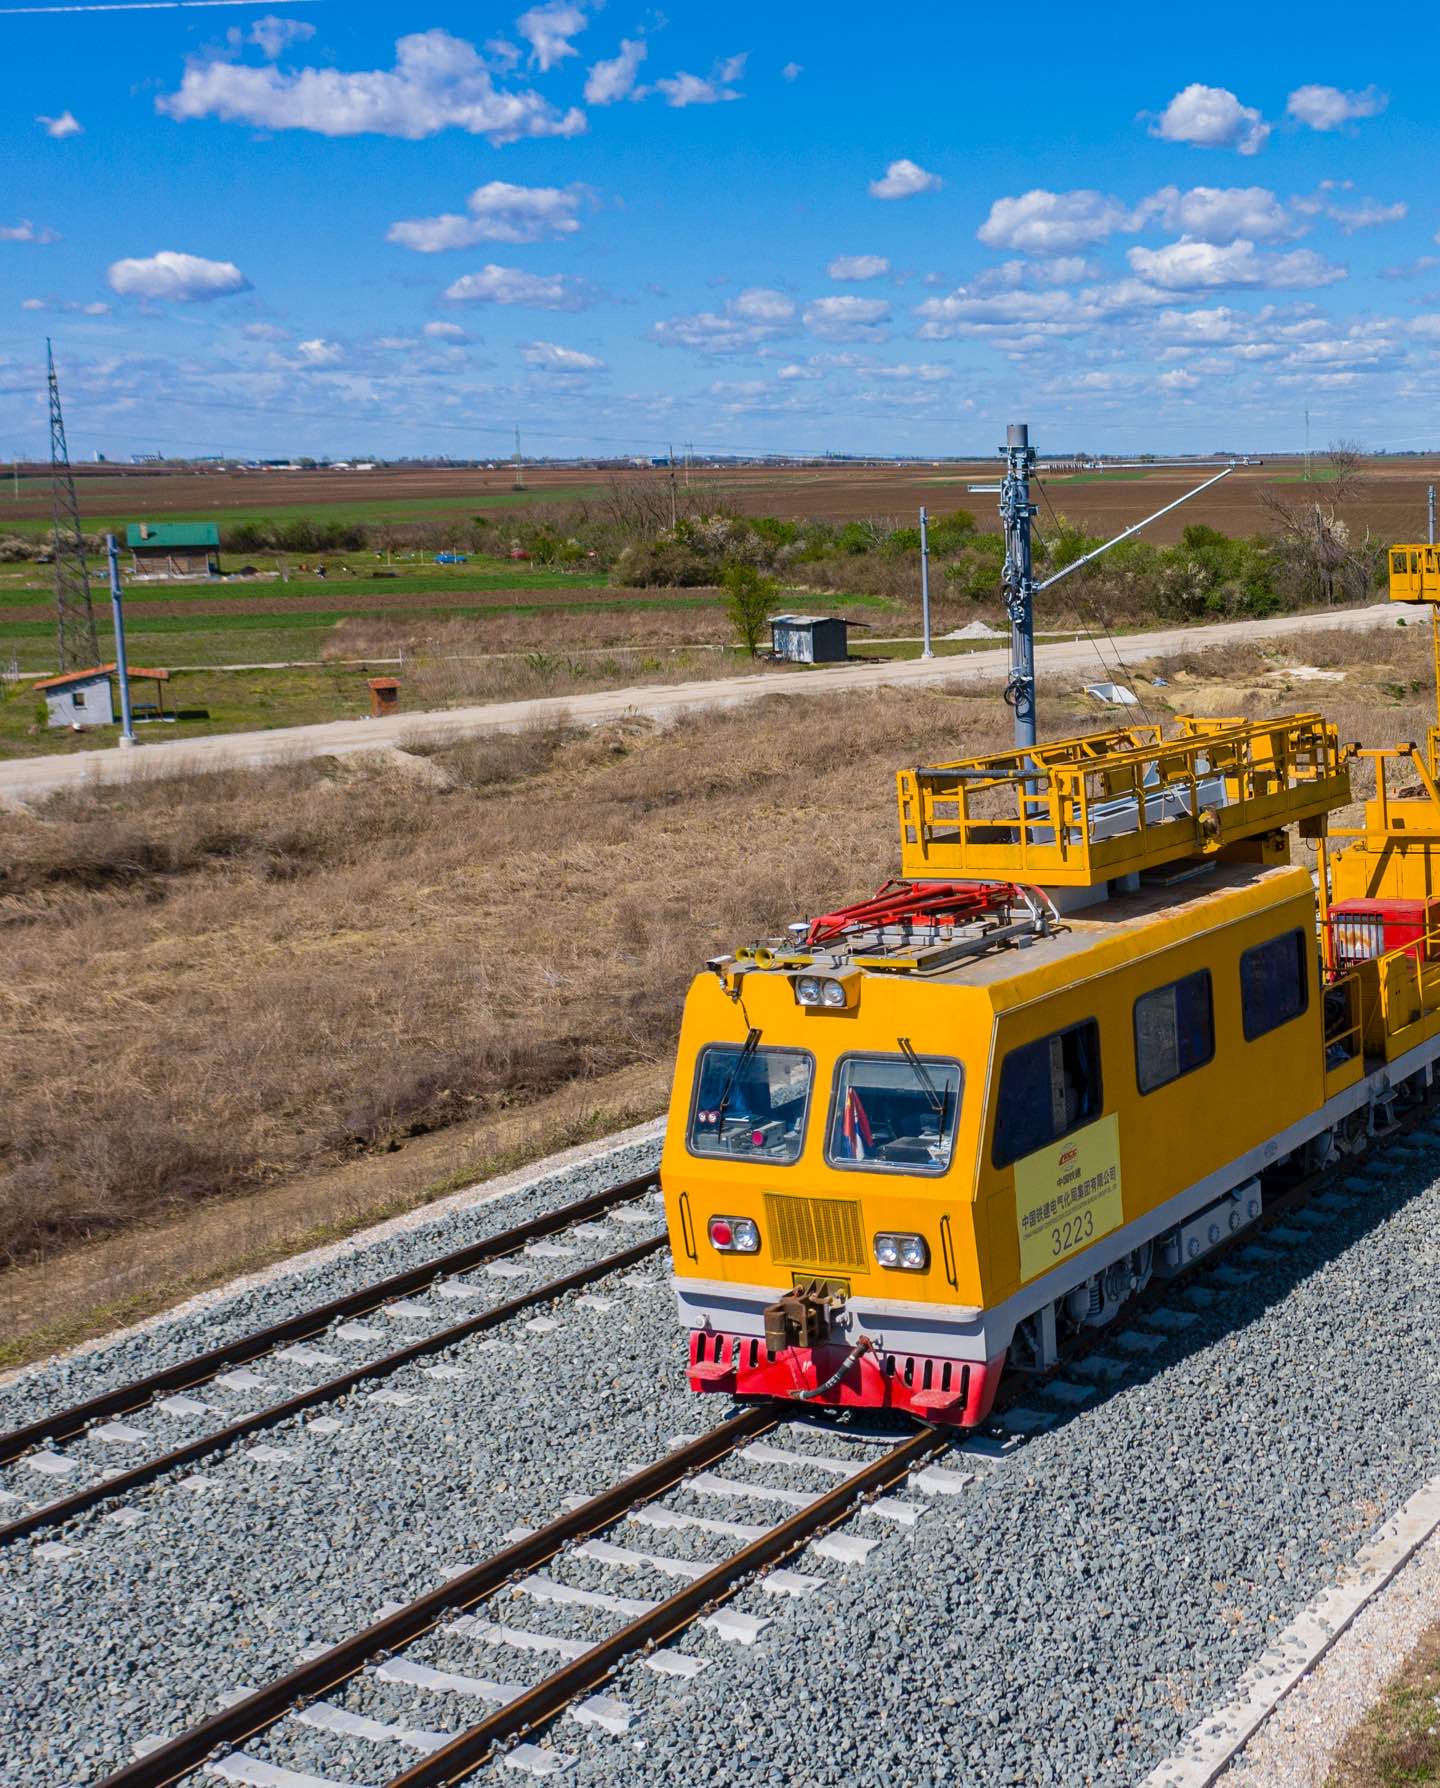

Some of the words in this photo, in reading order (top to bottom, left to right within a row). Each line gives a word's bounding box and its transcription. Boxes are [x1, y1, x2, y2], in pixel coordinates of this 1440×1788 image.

[1022, 1166, 1116, 1230] 中国铁建电气化局集团有限公司
[1052, 1210, 1094, 1256] 3223
